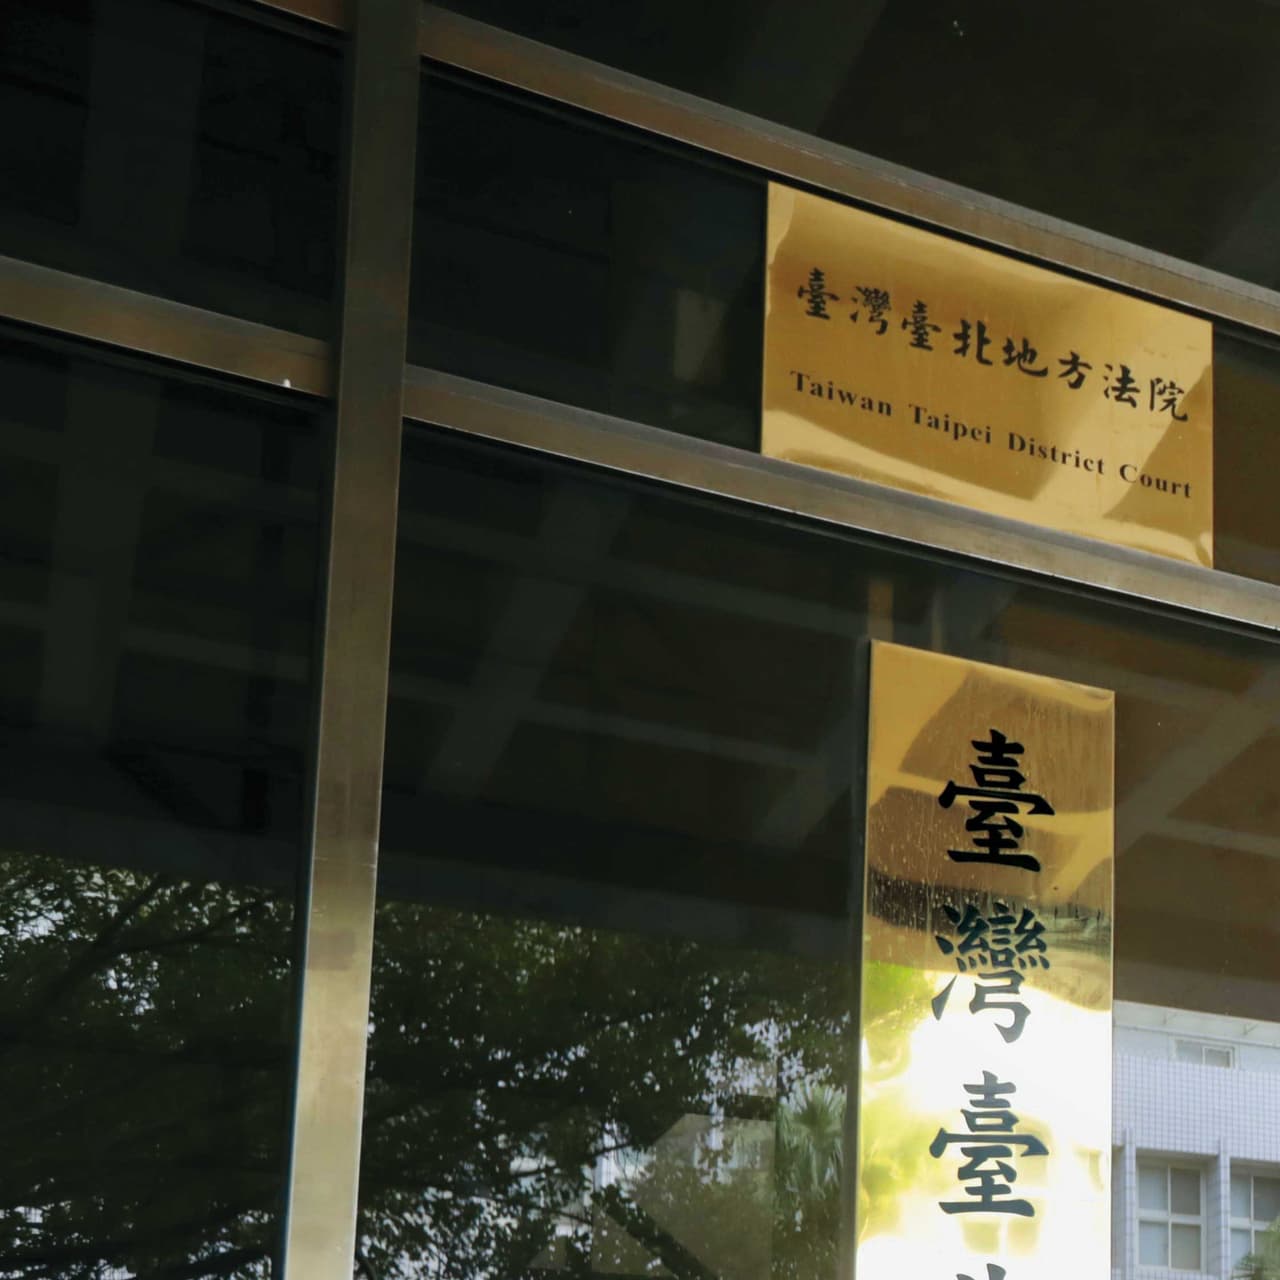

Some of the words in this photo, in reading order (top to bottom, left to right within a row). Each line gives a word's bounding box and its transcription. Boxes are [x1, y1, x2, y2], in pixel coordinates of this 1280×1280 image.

[797, 267, 1189, 422] 臺灣臺北地方法院
[789, 370, 893, 417] Taiwan
[908, 402, 992, 445] Taipei
[1007, 432, 1105, 476] District
[1119, 463, 1193, 499] Court
